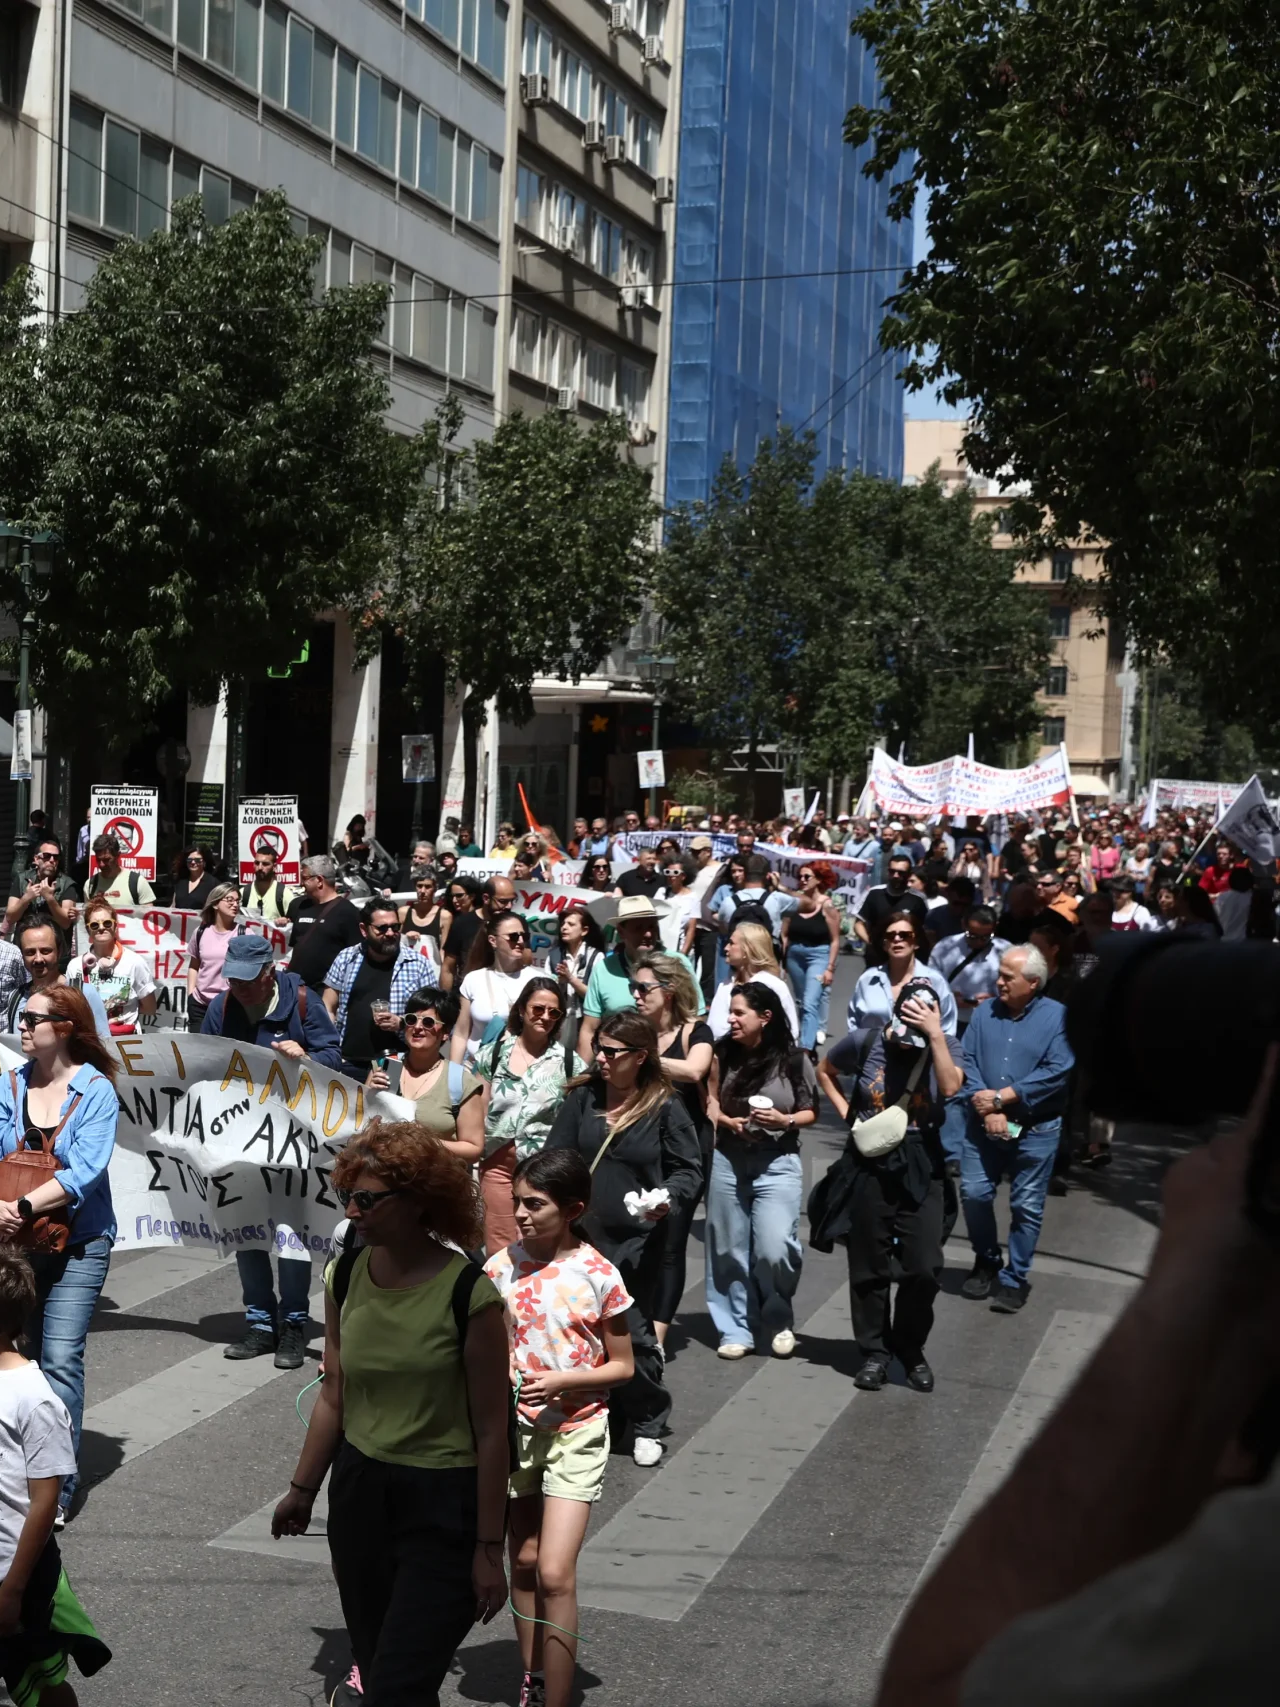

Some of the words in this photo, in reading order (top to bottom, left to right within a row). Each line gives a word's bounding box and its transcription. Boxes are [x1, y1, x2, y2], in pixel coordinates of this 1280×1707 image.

[97, 797, 151, 807] ΚΥΒΕΡΝΗΣΗ
[95, 807, 152, 816] ΔΟΛΟΦΟΝΩΝ
[244, 807, 293, 816] ΚΥΒΕΡΝΗΣΗ
[242, 816, 295, 825] ΔΟΛΟΦΟΝΩΝ
[242, 1112, 347, 1170] ΑΚΡ
[260, 1166, 337, 1210] ΜΙΣ
